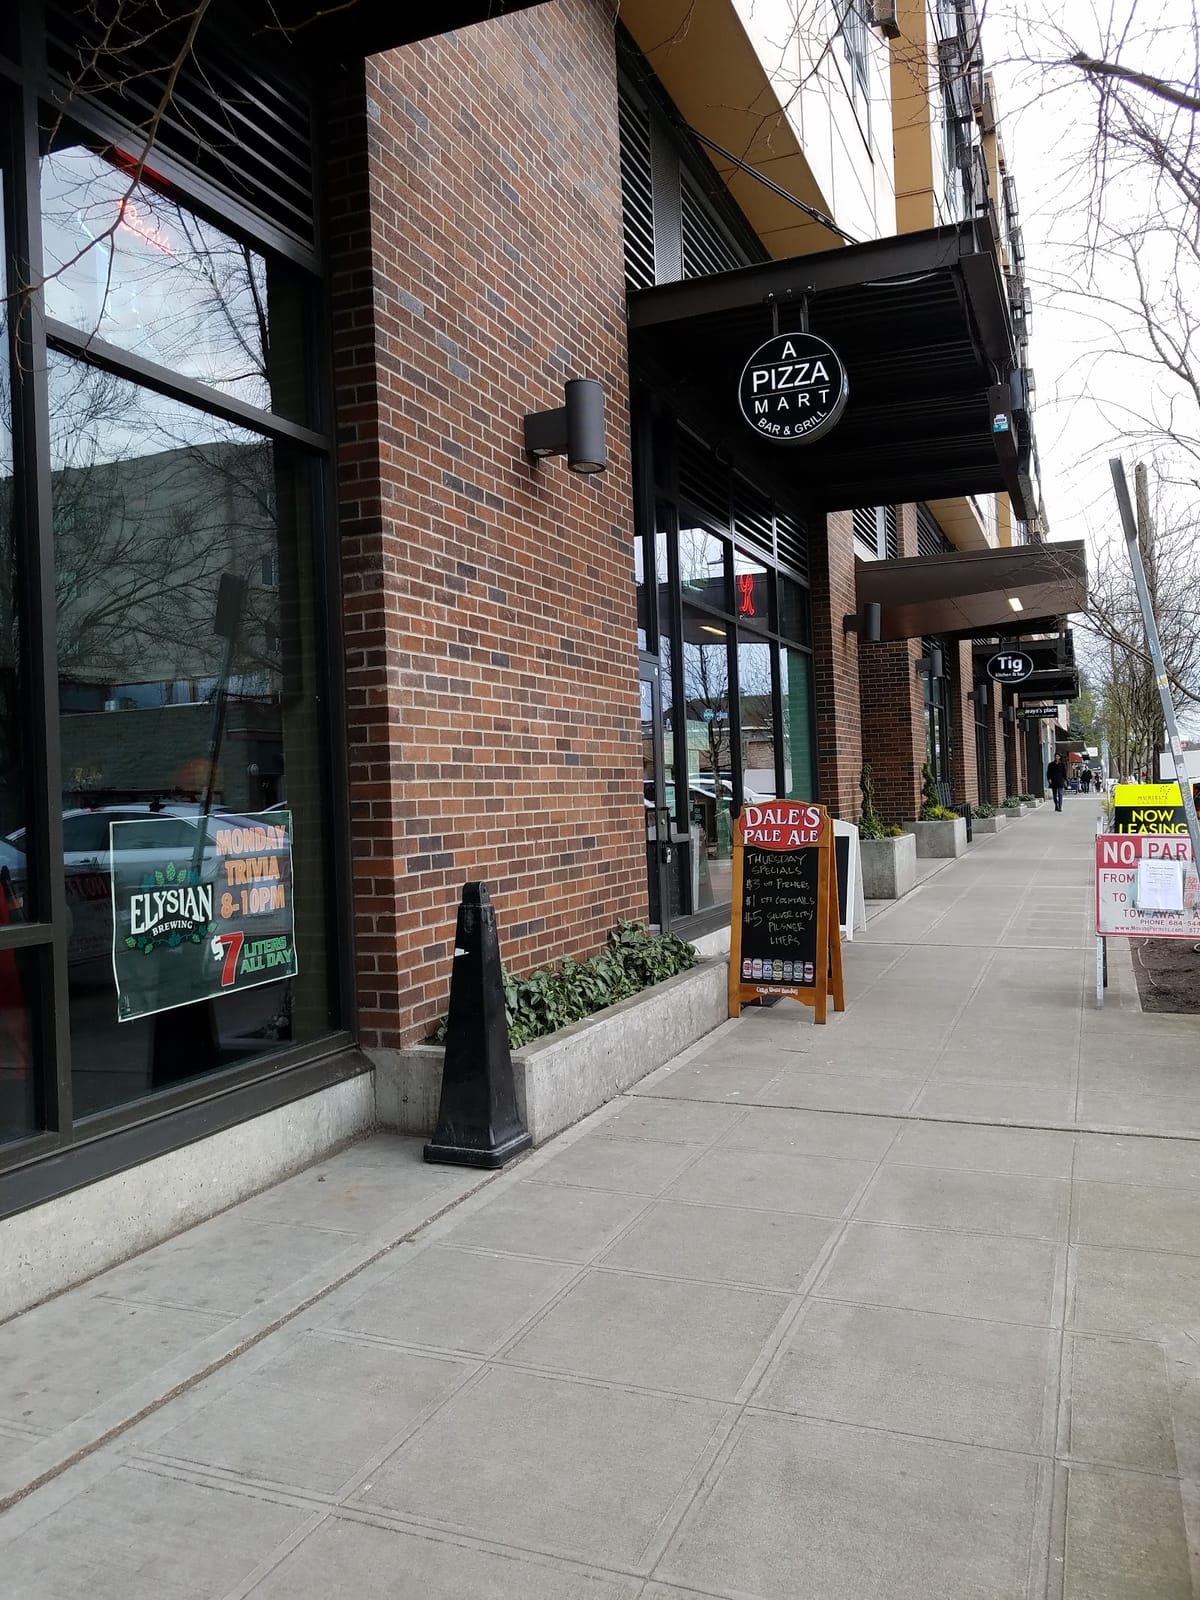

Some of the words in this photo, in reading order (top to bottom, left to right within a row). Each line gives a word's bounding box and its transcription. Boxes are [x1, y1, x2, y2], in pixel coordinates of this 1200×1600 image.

[782, 341, 796, 359] A
[753, 361, 829, 392] PIZZA
[755, 390, 830, 414] MART
[758, 418, 781, 434] BAR
[784, 426, 791, 435] &
[794, 411, 827, 433] GRILL
[997, 656, 1023, 672] Tig
[744, 806, 821, 828] DALE'S
[1132, 810, 1174, 822] NOW
[216, 825, 286, 856] MONDAY
[743, 829, 781, 845] PALE
[787, 830, 819, 846] ALE
[747, 853, 807, 865] THURSDAY
[1103, 841, 1135, 864] NO
[1148, 843, 1193, 861] PAR
[225, 856, 280, 886] TRIVIA
[752, 866, 802, 875] SPECIALS
[1103, 874, 1135, 883] FROM
[746, 878, 760, 890] $3
[220, 885, 285, 919] 8-10PM
[746, 894, 755, 907] $1
[1112, 893, 1127, 902] TO
[130, 885, 213, 935] ELYSIAN
[152, 920, 193, 937] BREWING
[768, 922, 805, 932] PILSNER
[243, 936, 287, 957] LITERS
[770, 935, 800, 945] LITERS
[211, 931, 244, 986] $7
[240, 953, 265, 973] ALL
[266, 949, 291, 969] DAY
